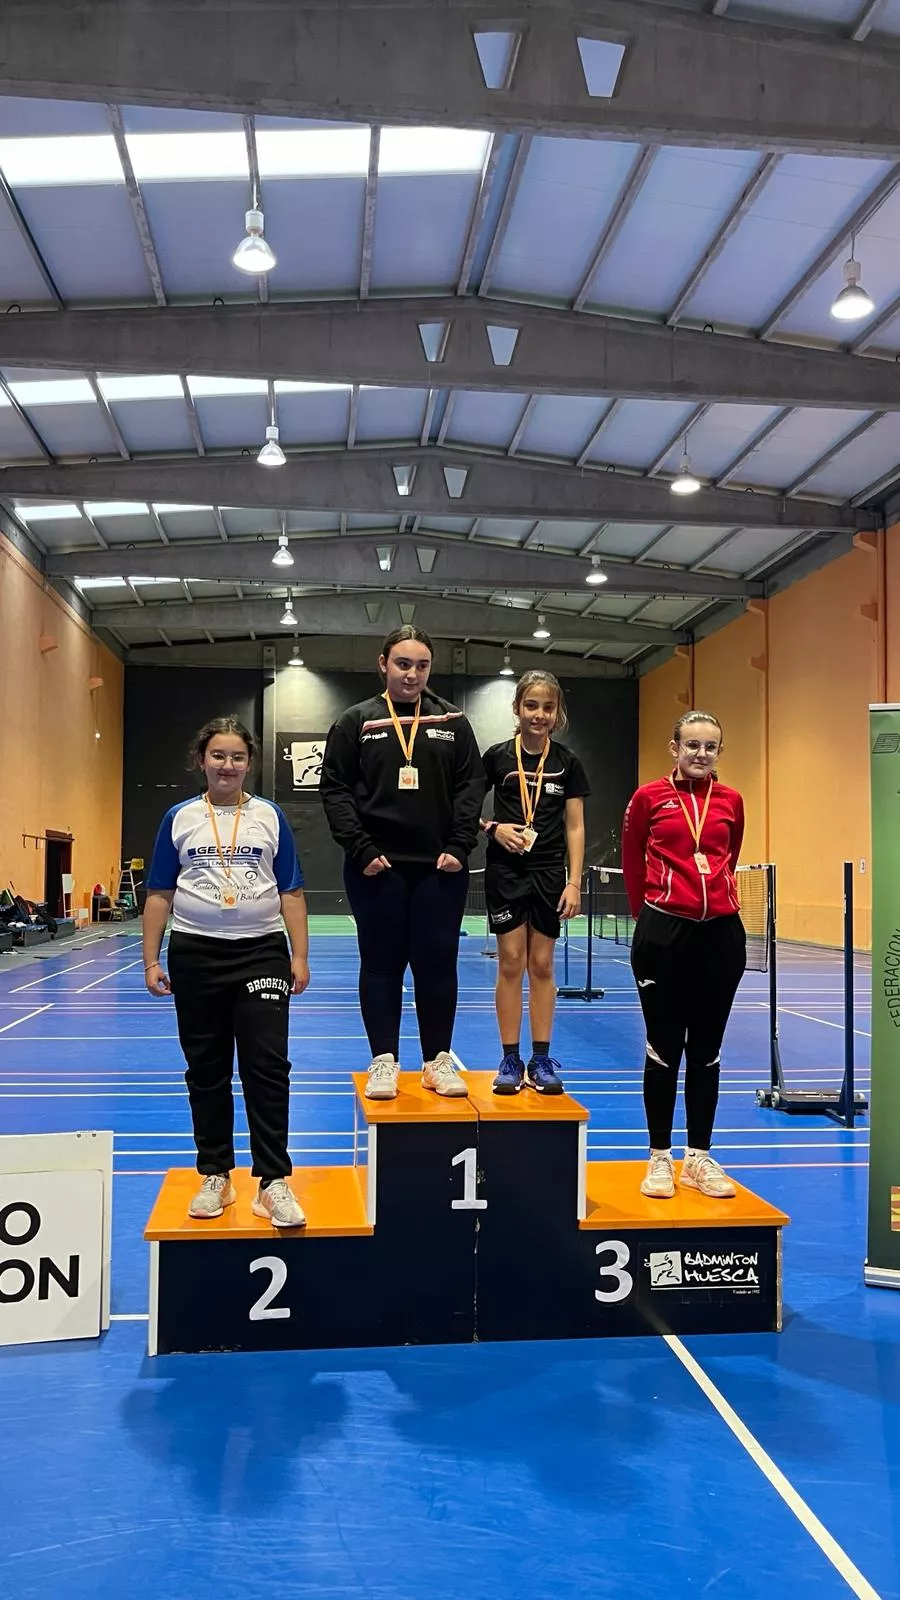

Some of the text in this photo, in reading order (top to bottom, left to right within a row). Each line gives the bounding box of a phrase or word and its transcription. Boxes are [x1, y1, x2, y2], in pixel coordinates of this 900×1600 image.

[205, 810, 246, 819] GVOVA
[452, 1148, 488, 1209] 1
[249, 1256, 291, 1321] 2
[595, 1240, 633, 1302] 3
[684, 1268, 759, 1284] HUESCA
